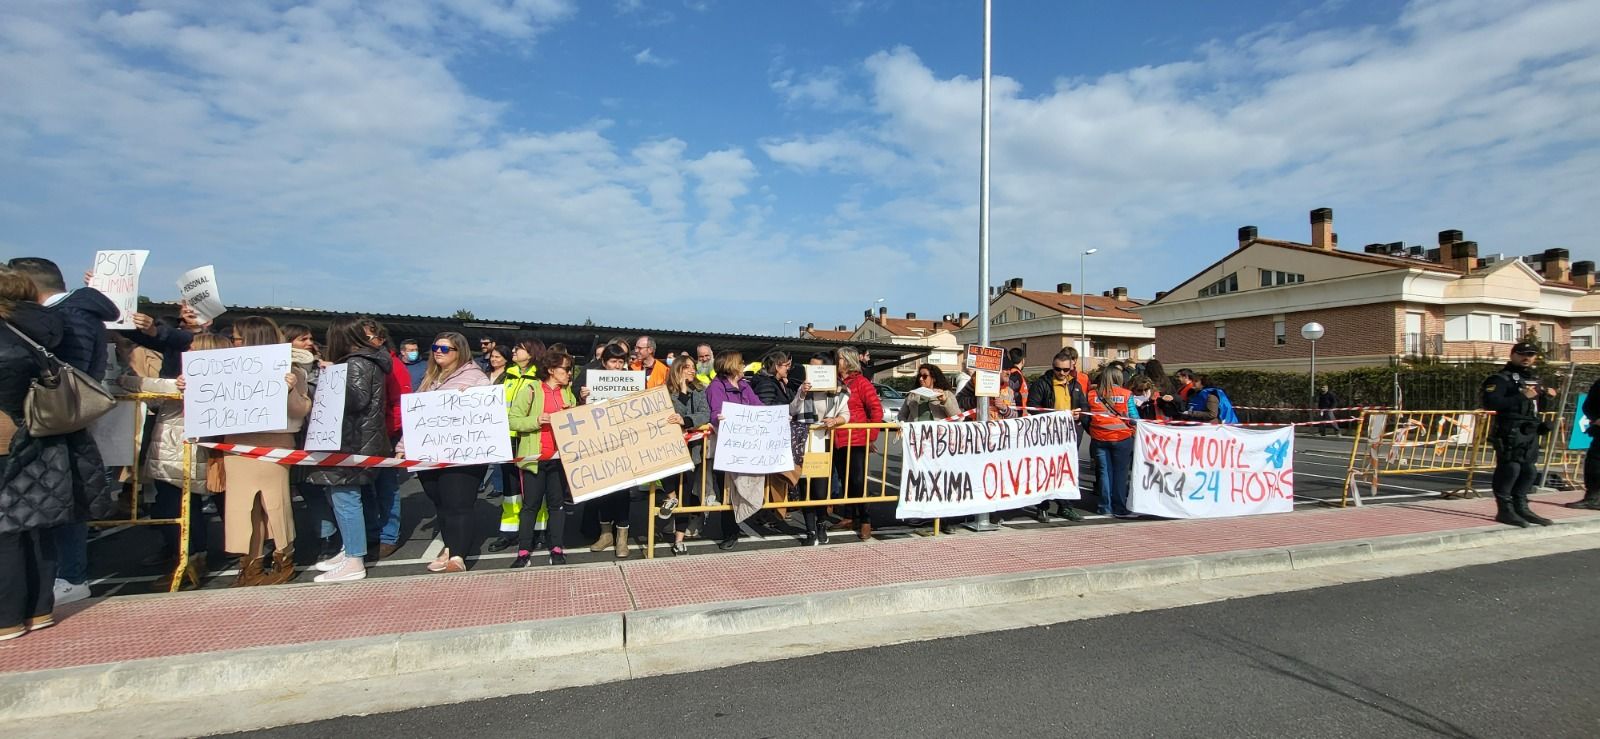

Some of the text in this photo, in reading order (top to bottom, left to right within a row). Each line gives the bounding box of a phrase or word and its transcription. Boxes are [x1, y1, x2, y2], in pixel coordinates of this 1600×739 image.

[97, 252, 136, 276] PSOE
[183, 275, 210, 293] PERSONAL
[980, 347, 1002, 358] VENDE
[186, 356, 288, 377] CUIDEMOS LA
[194, 380, 282, 403] SANIDAD
[407, 387, 504, 413] LA PRESIÓN
[199, 407, 272, 429] PÚBLICA
[590, 391, 674, 430] PERSONAL
[421, 429, 490, 447] AUMENTA
[562, 418, 671, 464] SANIDAD DE
[909, 420, 1011, 461] AMBULANCIA
[443, 445, 506, 462] PARAR
[638, 439, 688, 465] HUMANA
[904, 451, 1077, 503] MAXIMA OLVIDADA
[1142, 461, 1294, 504] JACA 24 HORAS
